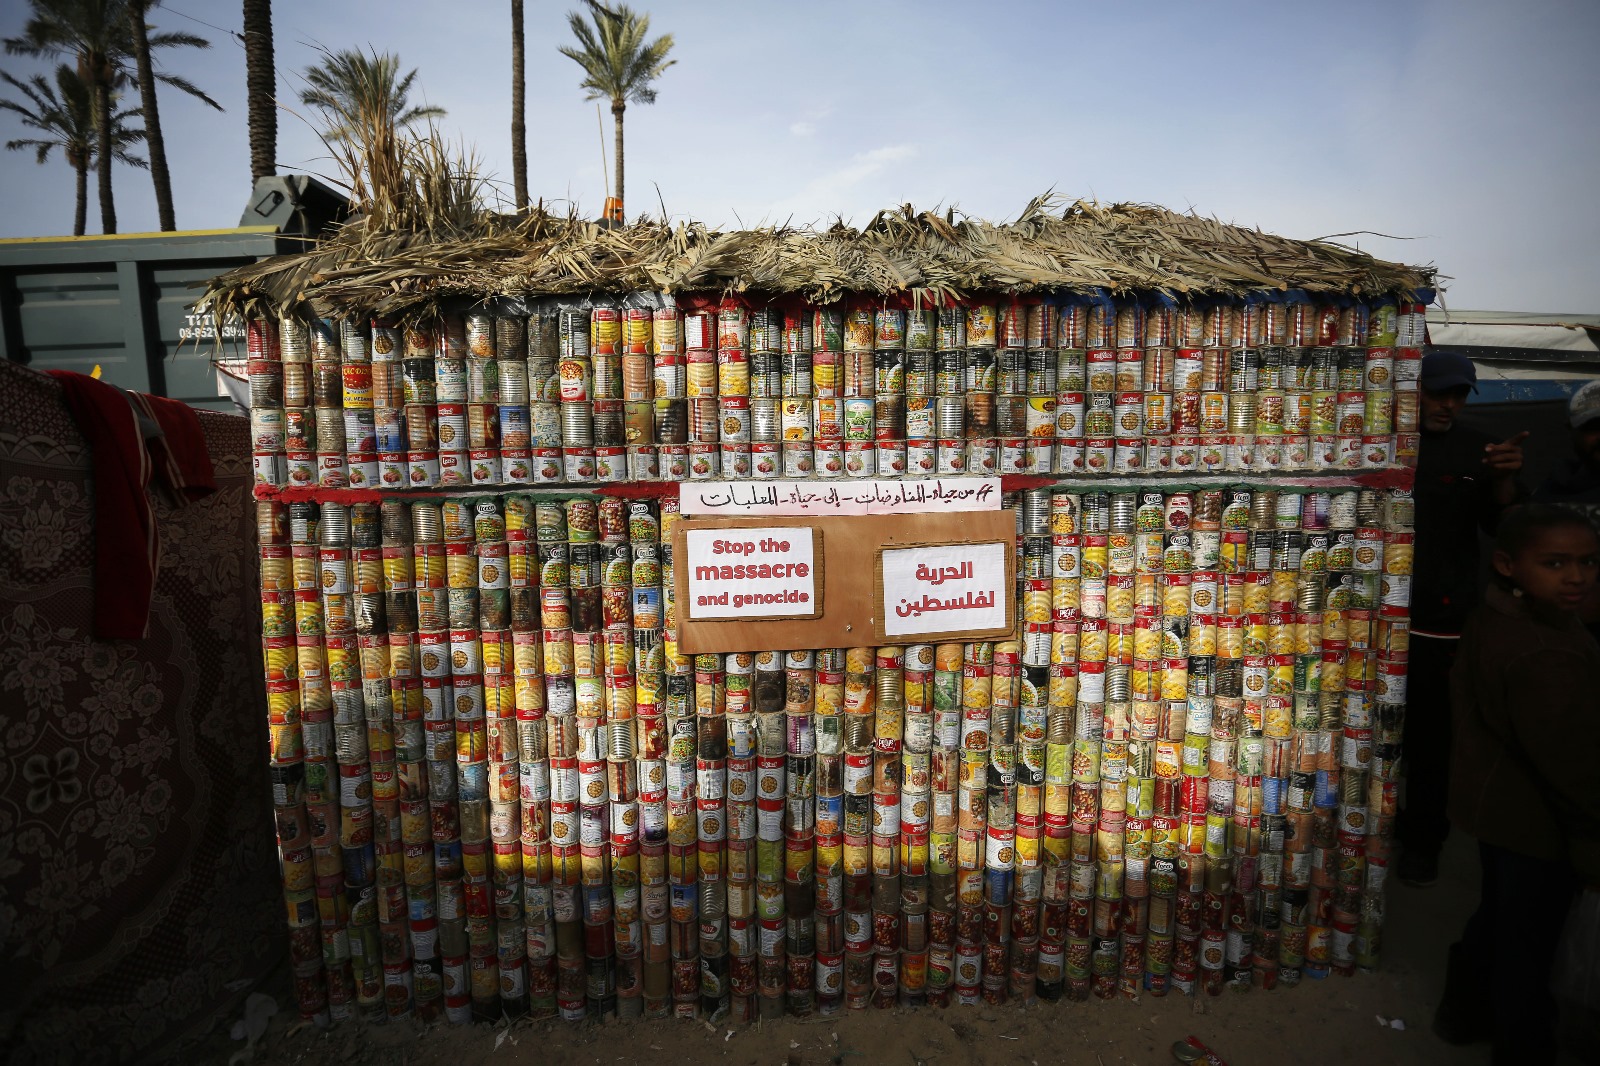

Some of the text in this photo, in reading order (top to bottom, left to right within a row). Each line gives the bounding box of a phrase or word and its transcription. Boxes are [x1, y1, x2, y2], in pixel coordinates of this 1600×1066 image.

[712, 538, 790, 556] Stop the
[695, 563, 810, 580] massacre
[915, 561, 974, 585] الحرية
[697, 590, 810, 608] and genocide
[895, 590, 995, 617] لفلسطين
